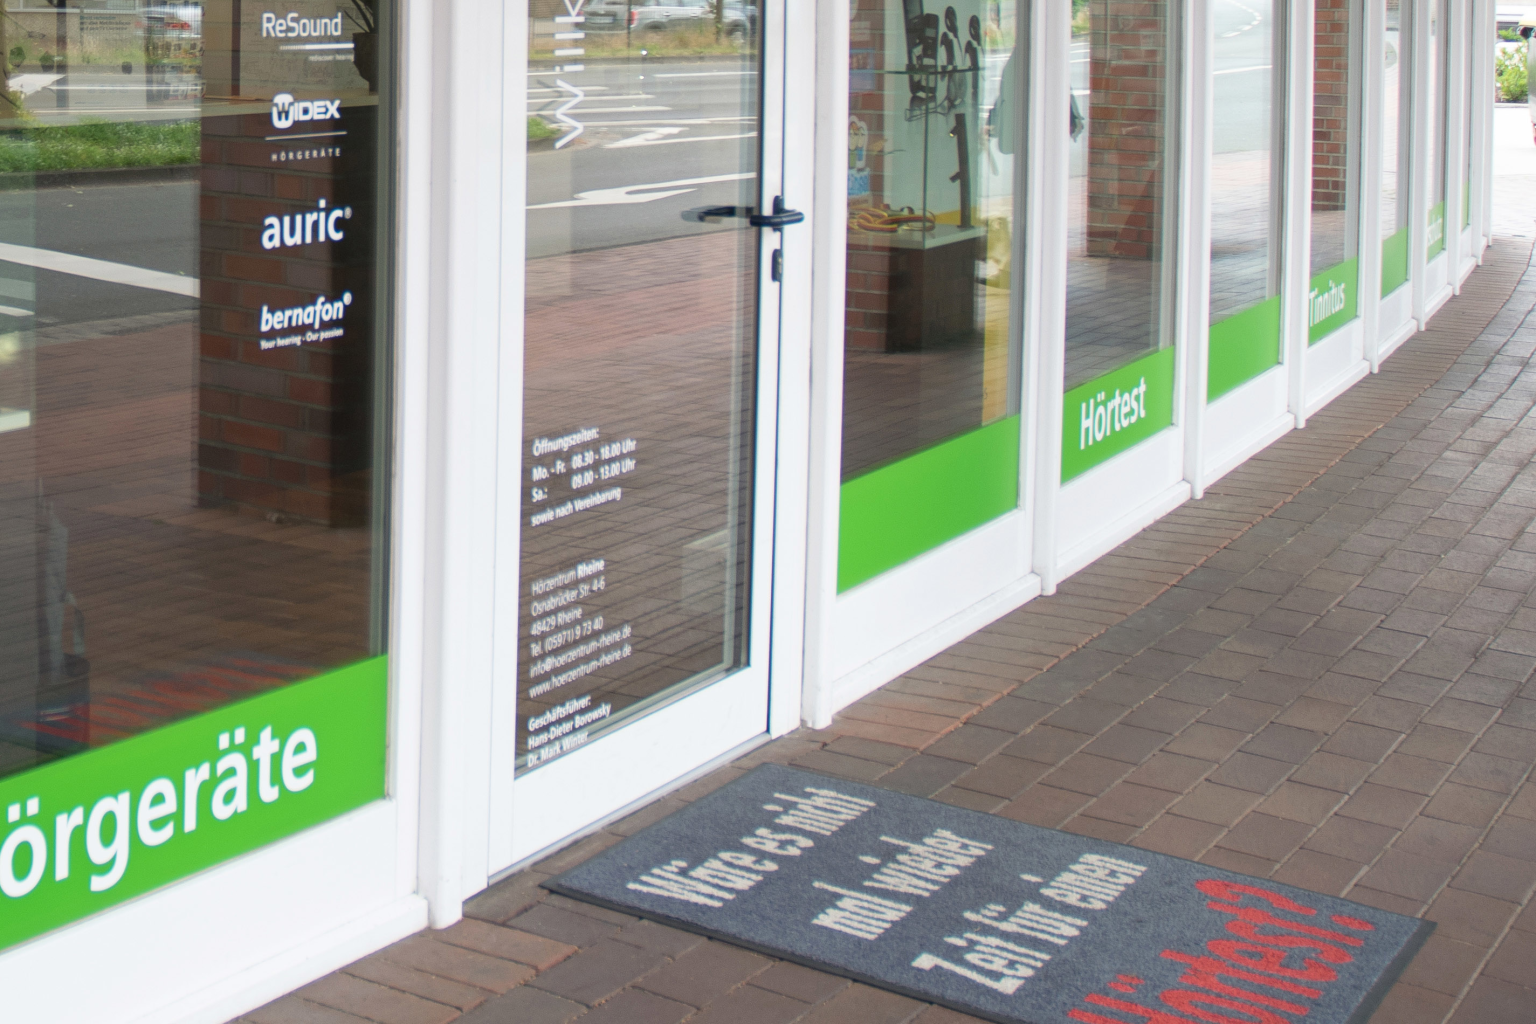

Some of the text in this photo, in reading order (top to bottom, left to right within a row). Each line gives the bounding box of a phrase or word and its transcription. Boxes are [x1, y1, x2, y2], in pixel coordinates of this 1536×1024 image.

[262, 11, 342, 38] ReSound
[272, 93, 341, 129] WIDEX
[271, 147, 341, 162] HÖRGERÄTE
[1309, 278, 1346, 327] Tinnitus
[260, 339, 275, 351] Your
[276, 335, 302, 347] hearing
[306, 331, 319, 342] Our
[320, 327, 344, 342] passion
[1079, 377, 1146, 450] Hörtest
[531, 427, 600, 457] Öffnungszeiten:
[531, 464, 550, 482] Mo.
[555, 459, 567, 475] Fr.
[571, 449, 594, 470] 08.30
[599, 442, 621, 461] 18.00
[621, 437, 637, 454] Uhr
[571, 469, 594, 490] 09.00
[599, 461, 621, 480] 13.00
[621, 456, 636, 474] Uhr
[530, 486, 622, 527] sowie nach Vereinbarung
[530, 588, 578, 617] Osnabrücker
[591, 575, 606, 592] 4-6
[531, 559, 606, 597] Hörzentrum Rheine
[530, 606, 583, 636] 48429 Rheine
[530, 615, 604, 658] Tel. (05971) 9 73 40
[528, 643, 632, 699] www.hoerzentrum-rheine.de
[529, 623, 632, 679] info@hoerzentrum-rheine.de
[528, 695, 592, 732] Geschäftsführer:
[528, 702, 612, 750] Hans-Dieter Borowsky
[527, 730, 589, 768] Dr. Mark Winter
[625, 787, 876, 908] Wäre es nicht
[811, 828, 994, 941] mal wieder
[911, 853, 1148, 995] Zeit für einen
